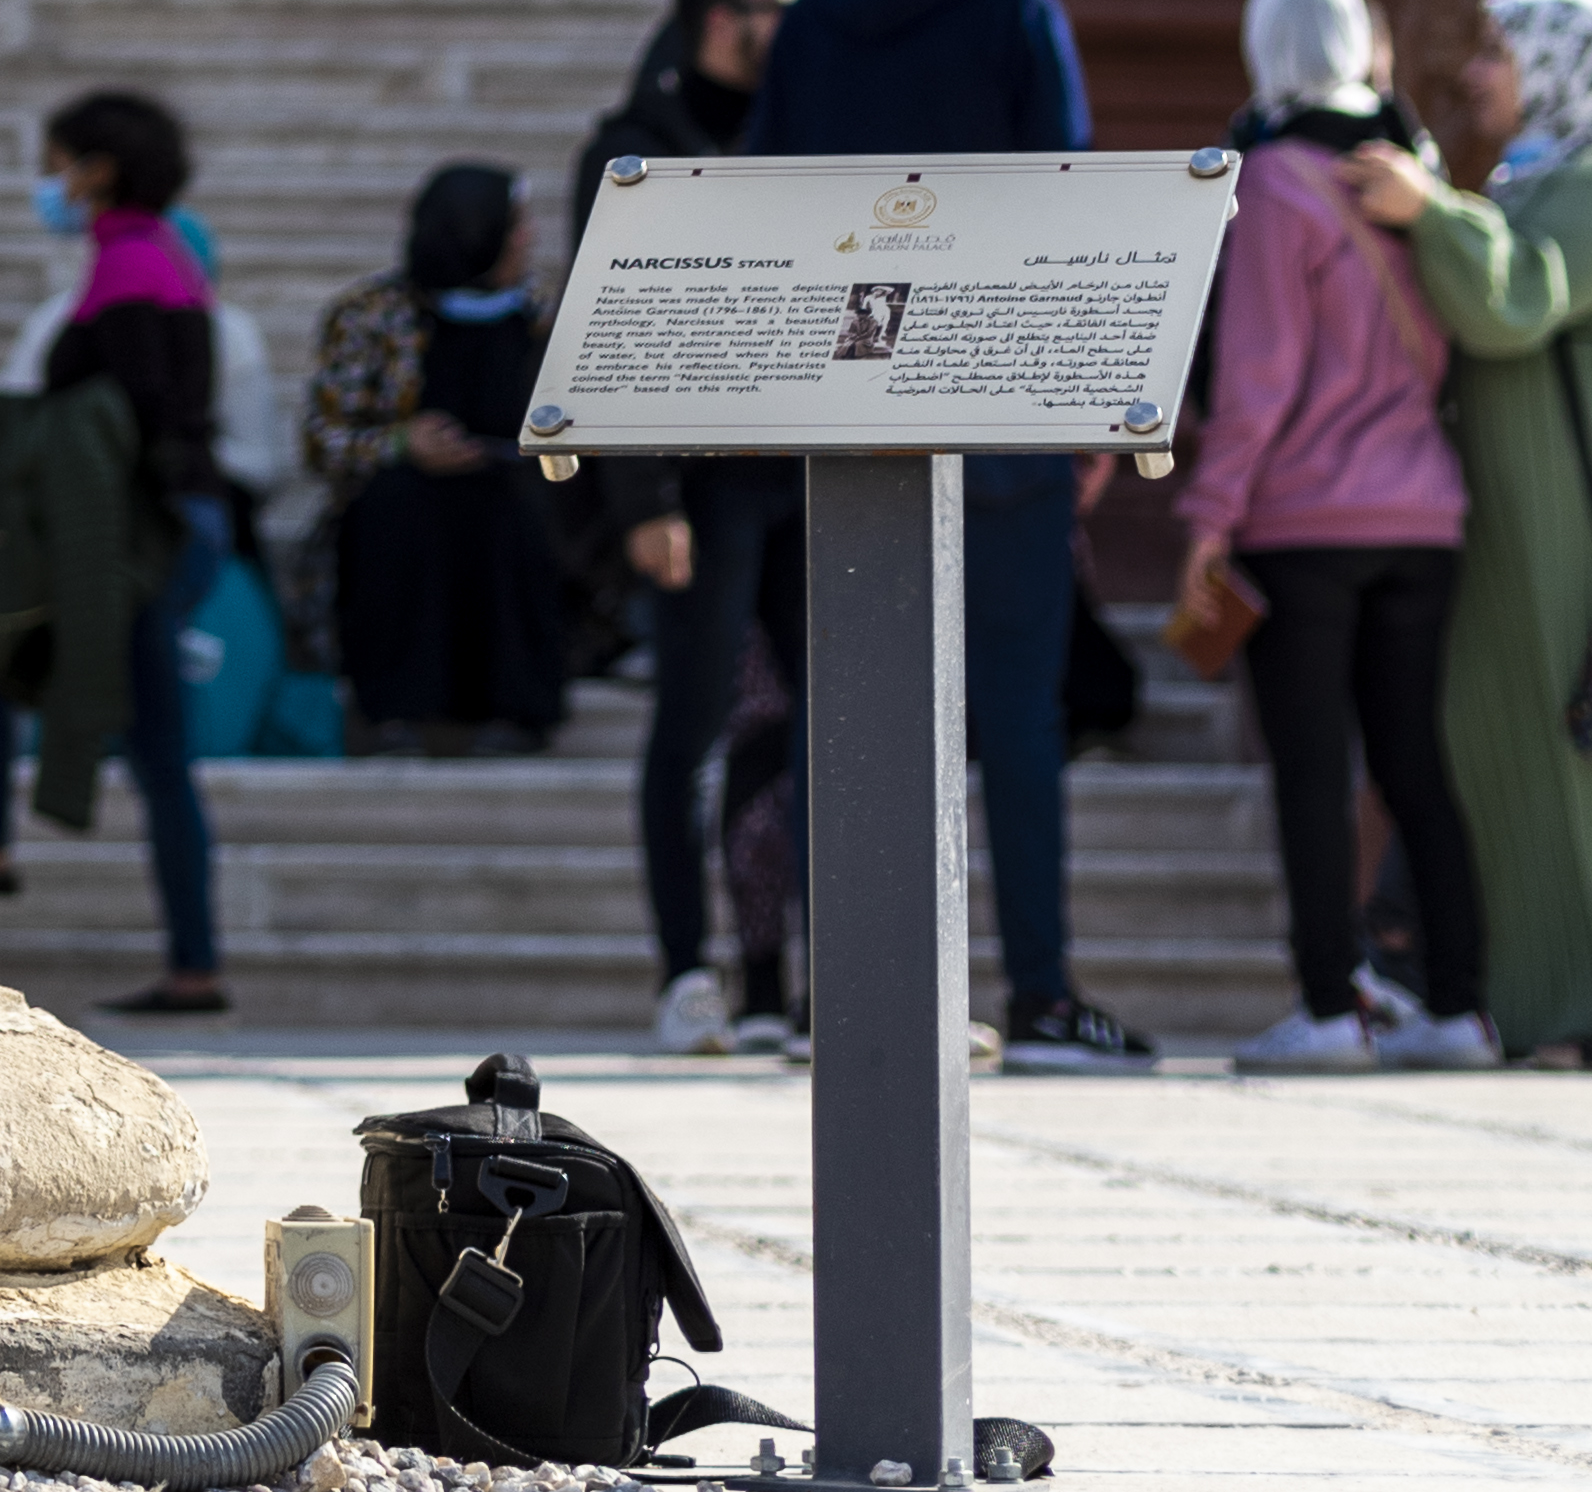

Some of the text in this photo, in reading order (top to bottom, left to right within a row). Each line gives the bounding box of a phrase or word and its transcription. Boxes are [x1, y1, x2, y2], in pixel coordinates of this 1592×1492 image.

[869, 243, 953, 251] BARON PALACE
[609, 257, 794, 270] NARCISSUS STATUE
[600, 285, 625, 294] This
[638, 285, 672, 293] white
[684, 284, 728, 293] marble
[791, 283, 849, 293] depicting
[595, 296, 654, 305] Narcissus
[685, 295, 720, 304] made
[723, 295, 739, 305] by
[742, 294, 786, 303] French
[789, 294, 845, 303] architect
[976, 294, 1026, 303] Antoine
[1028, 293, 1083, 303] Garnaud
[645, 306, 700, 316] Garnaud
[787, 305, 800, 314] In
[803, 305, 842, 314] Greek
[588, 318, 656, 329] mythology,
[665, 317, 725, 326] Narcissus
[784, 316, 840, 325] beautiful
[584, 331, 623, 340] young
[689, 328, 753, 337] entranced
[756, 328, 784, 336] with
[787, 327, 805, 336] his
[582, 338, 832, 350] beauty, would admire himself in pools
[578, 349, 830, 360] of water, but drowned when he tried
[575, 361, 826, 372] to embrace his reflection. Psychiatrists
[571, 373, 614, 382] coined
[615, 373, 636, 382] the
[639, 374, 670, 382] term
[753, 372, 823, 383] personality
[633, 384, 670, 393] based
[697, 384, 720, 393] this
[726, 384, 761, 394] myth.
